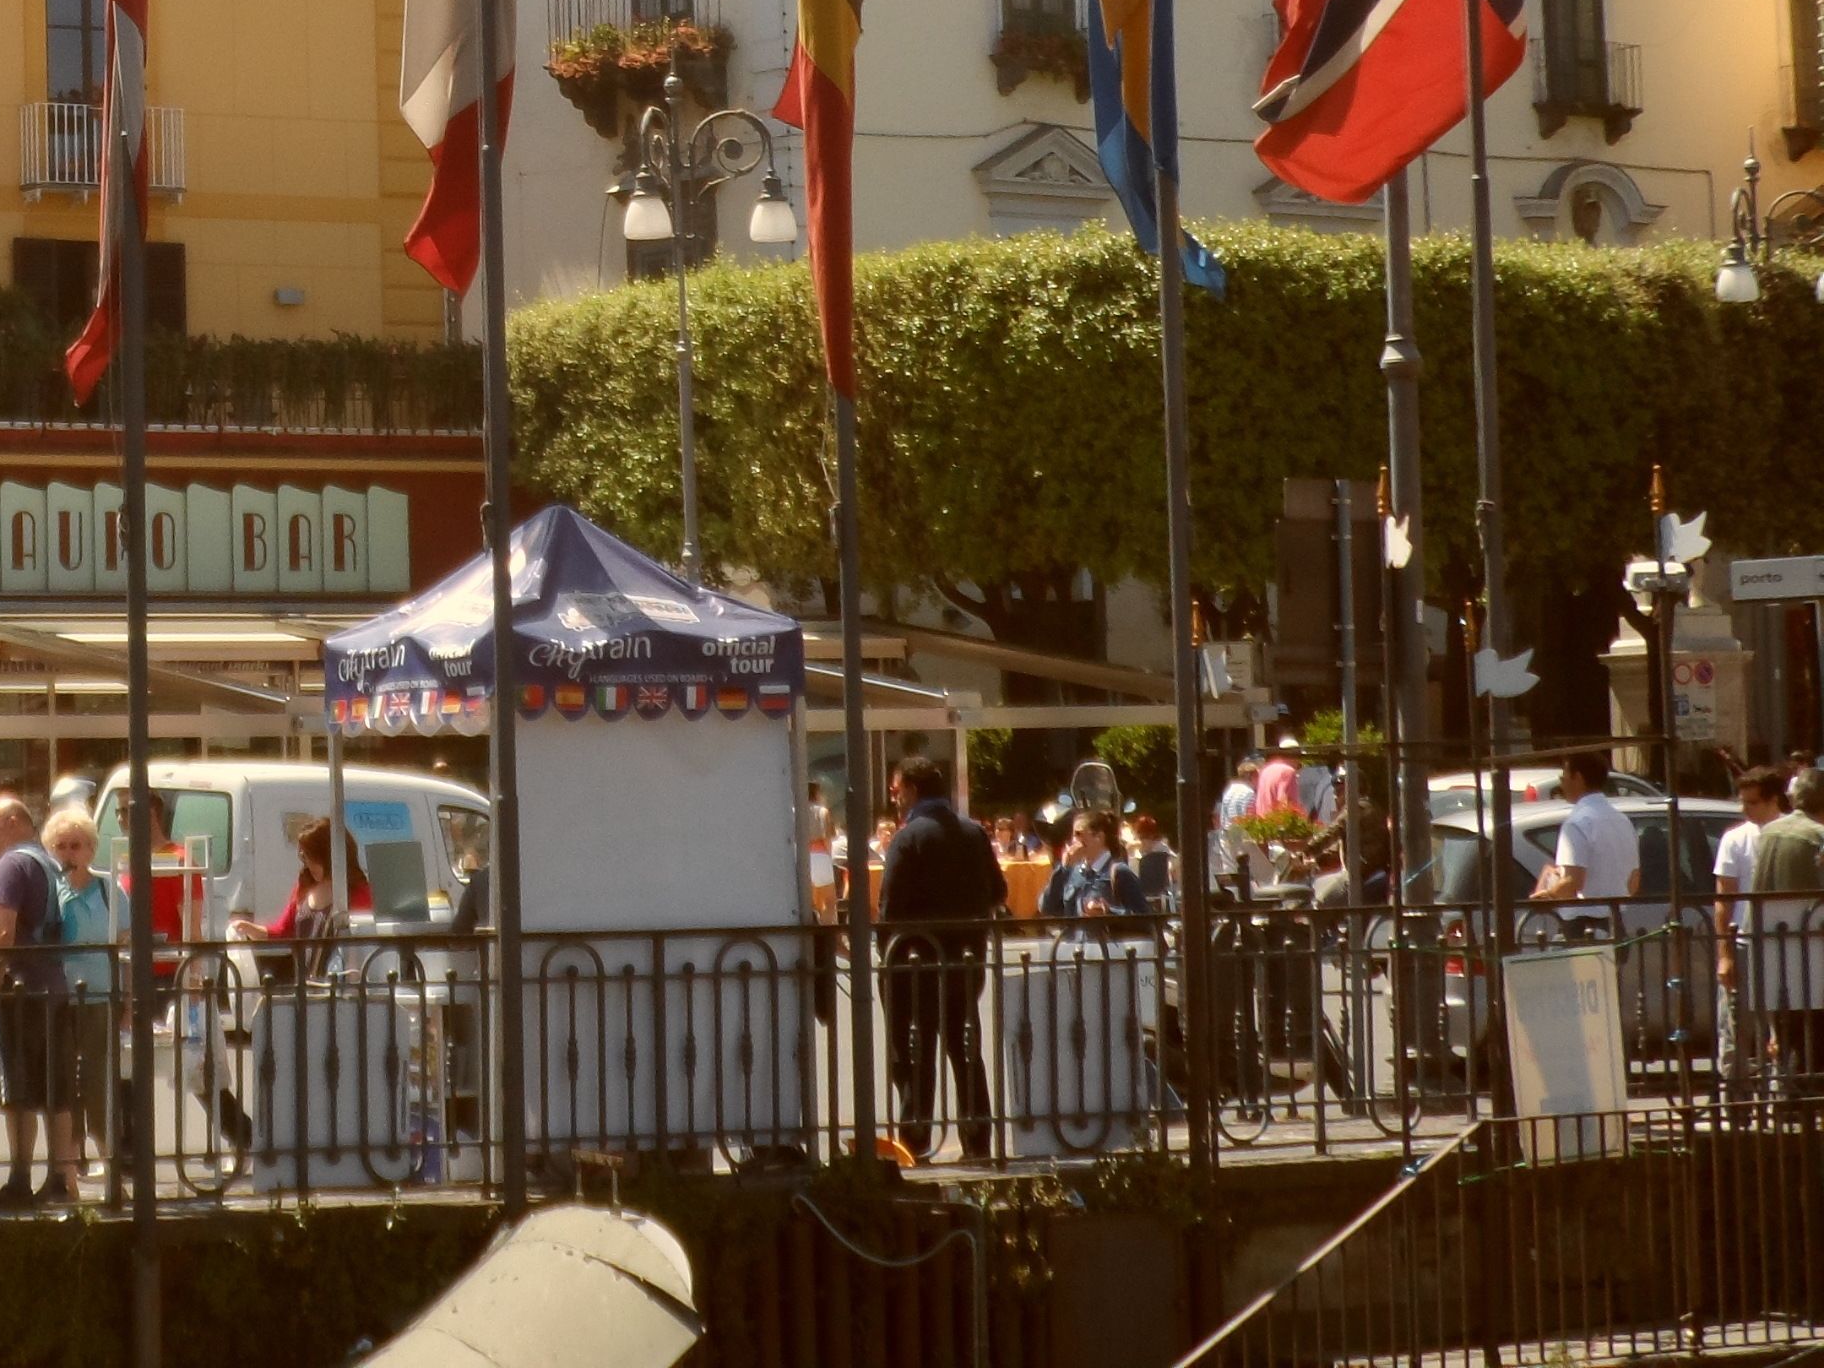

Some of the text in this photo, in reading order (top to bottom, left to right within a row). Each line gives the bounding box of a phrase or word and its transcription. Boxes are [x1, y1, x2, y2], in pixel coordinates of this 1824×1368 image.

[242, 512, 358, 572] BAR
[1740, 573, 1783, 586] porto
[444, 660, 473, 678] tour
[730, 658, 774, 674] tour
